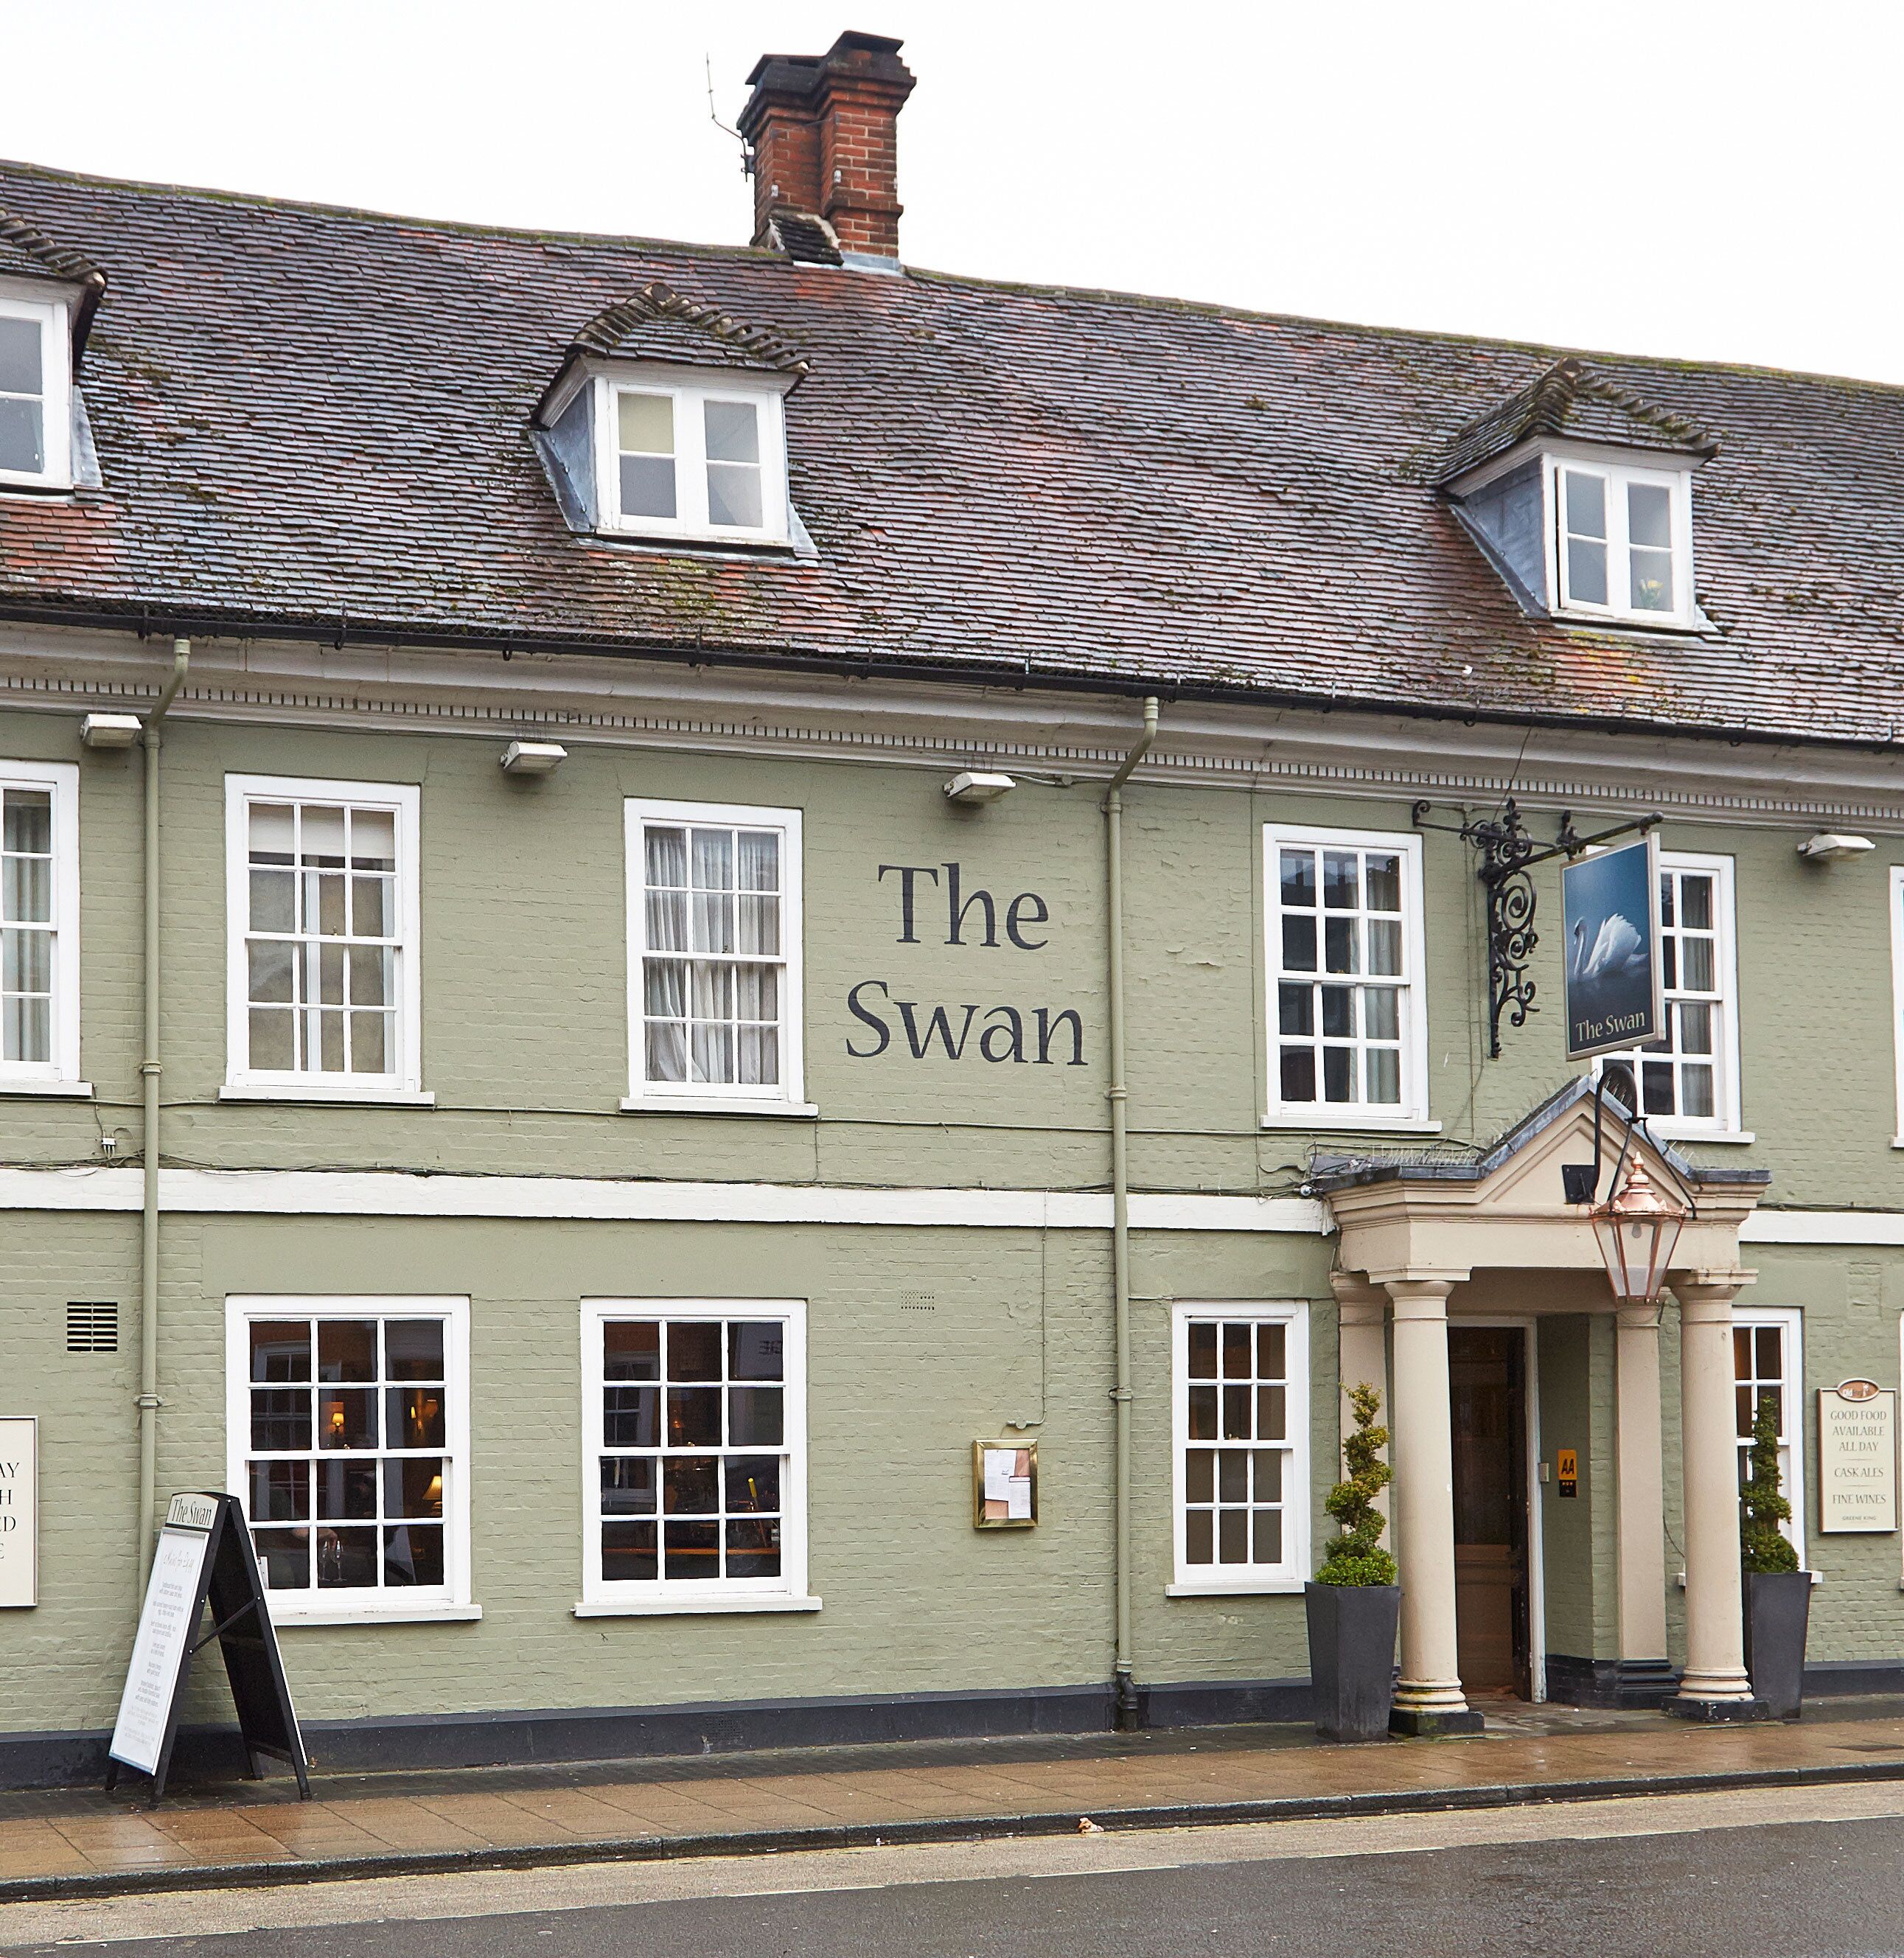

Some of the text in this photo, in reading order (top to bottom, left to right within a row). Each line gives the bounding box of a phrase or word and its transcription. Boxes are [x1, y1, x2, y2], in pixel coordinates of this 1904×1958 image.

[878, 863, 1049, 950] The
[845, 980, 1089, 1066] Swan
[1575, 1011, 1646, 1042] The Swan
[1830, 1410, 1887, 1421] GOOD FOOD
[1832, 1426, 1885, 1436] AVAILABLE
[1838, 1441, 1879, 1452] ALL DAY
[1561, 1458, 1575, 1475] AA
[1834, 1467, 1884, 1477] CASK ALES
[1832, 1494, 1886, 1505] FINE WINES
[172, 1498, 212, 1526] The Swan
